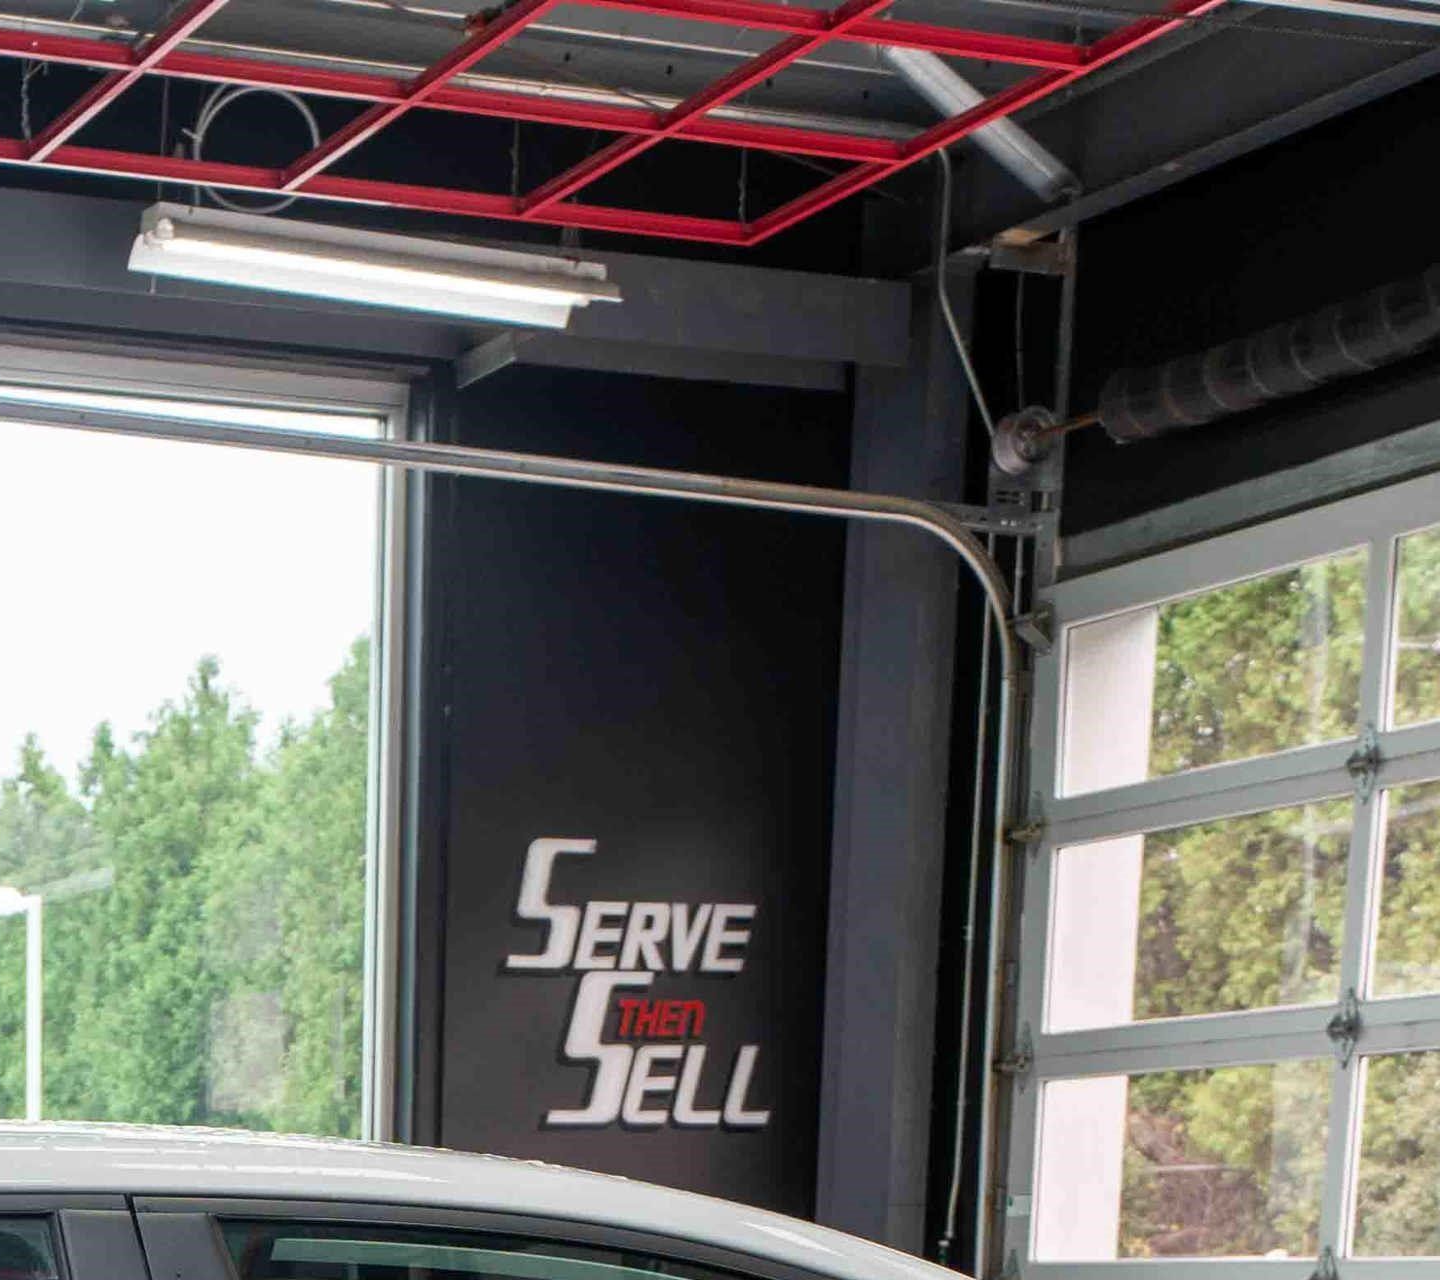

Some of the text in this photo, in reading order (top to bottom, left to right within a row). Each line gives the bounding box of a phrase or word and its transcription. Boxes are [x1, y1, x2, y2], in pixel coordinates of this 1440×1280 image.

[506, 837, 758, 972] SERVE
[545, 970, 772, 1126] SELL
[618, 998, 706, 1037] THEN
